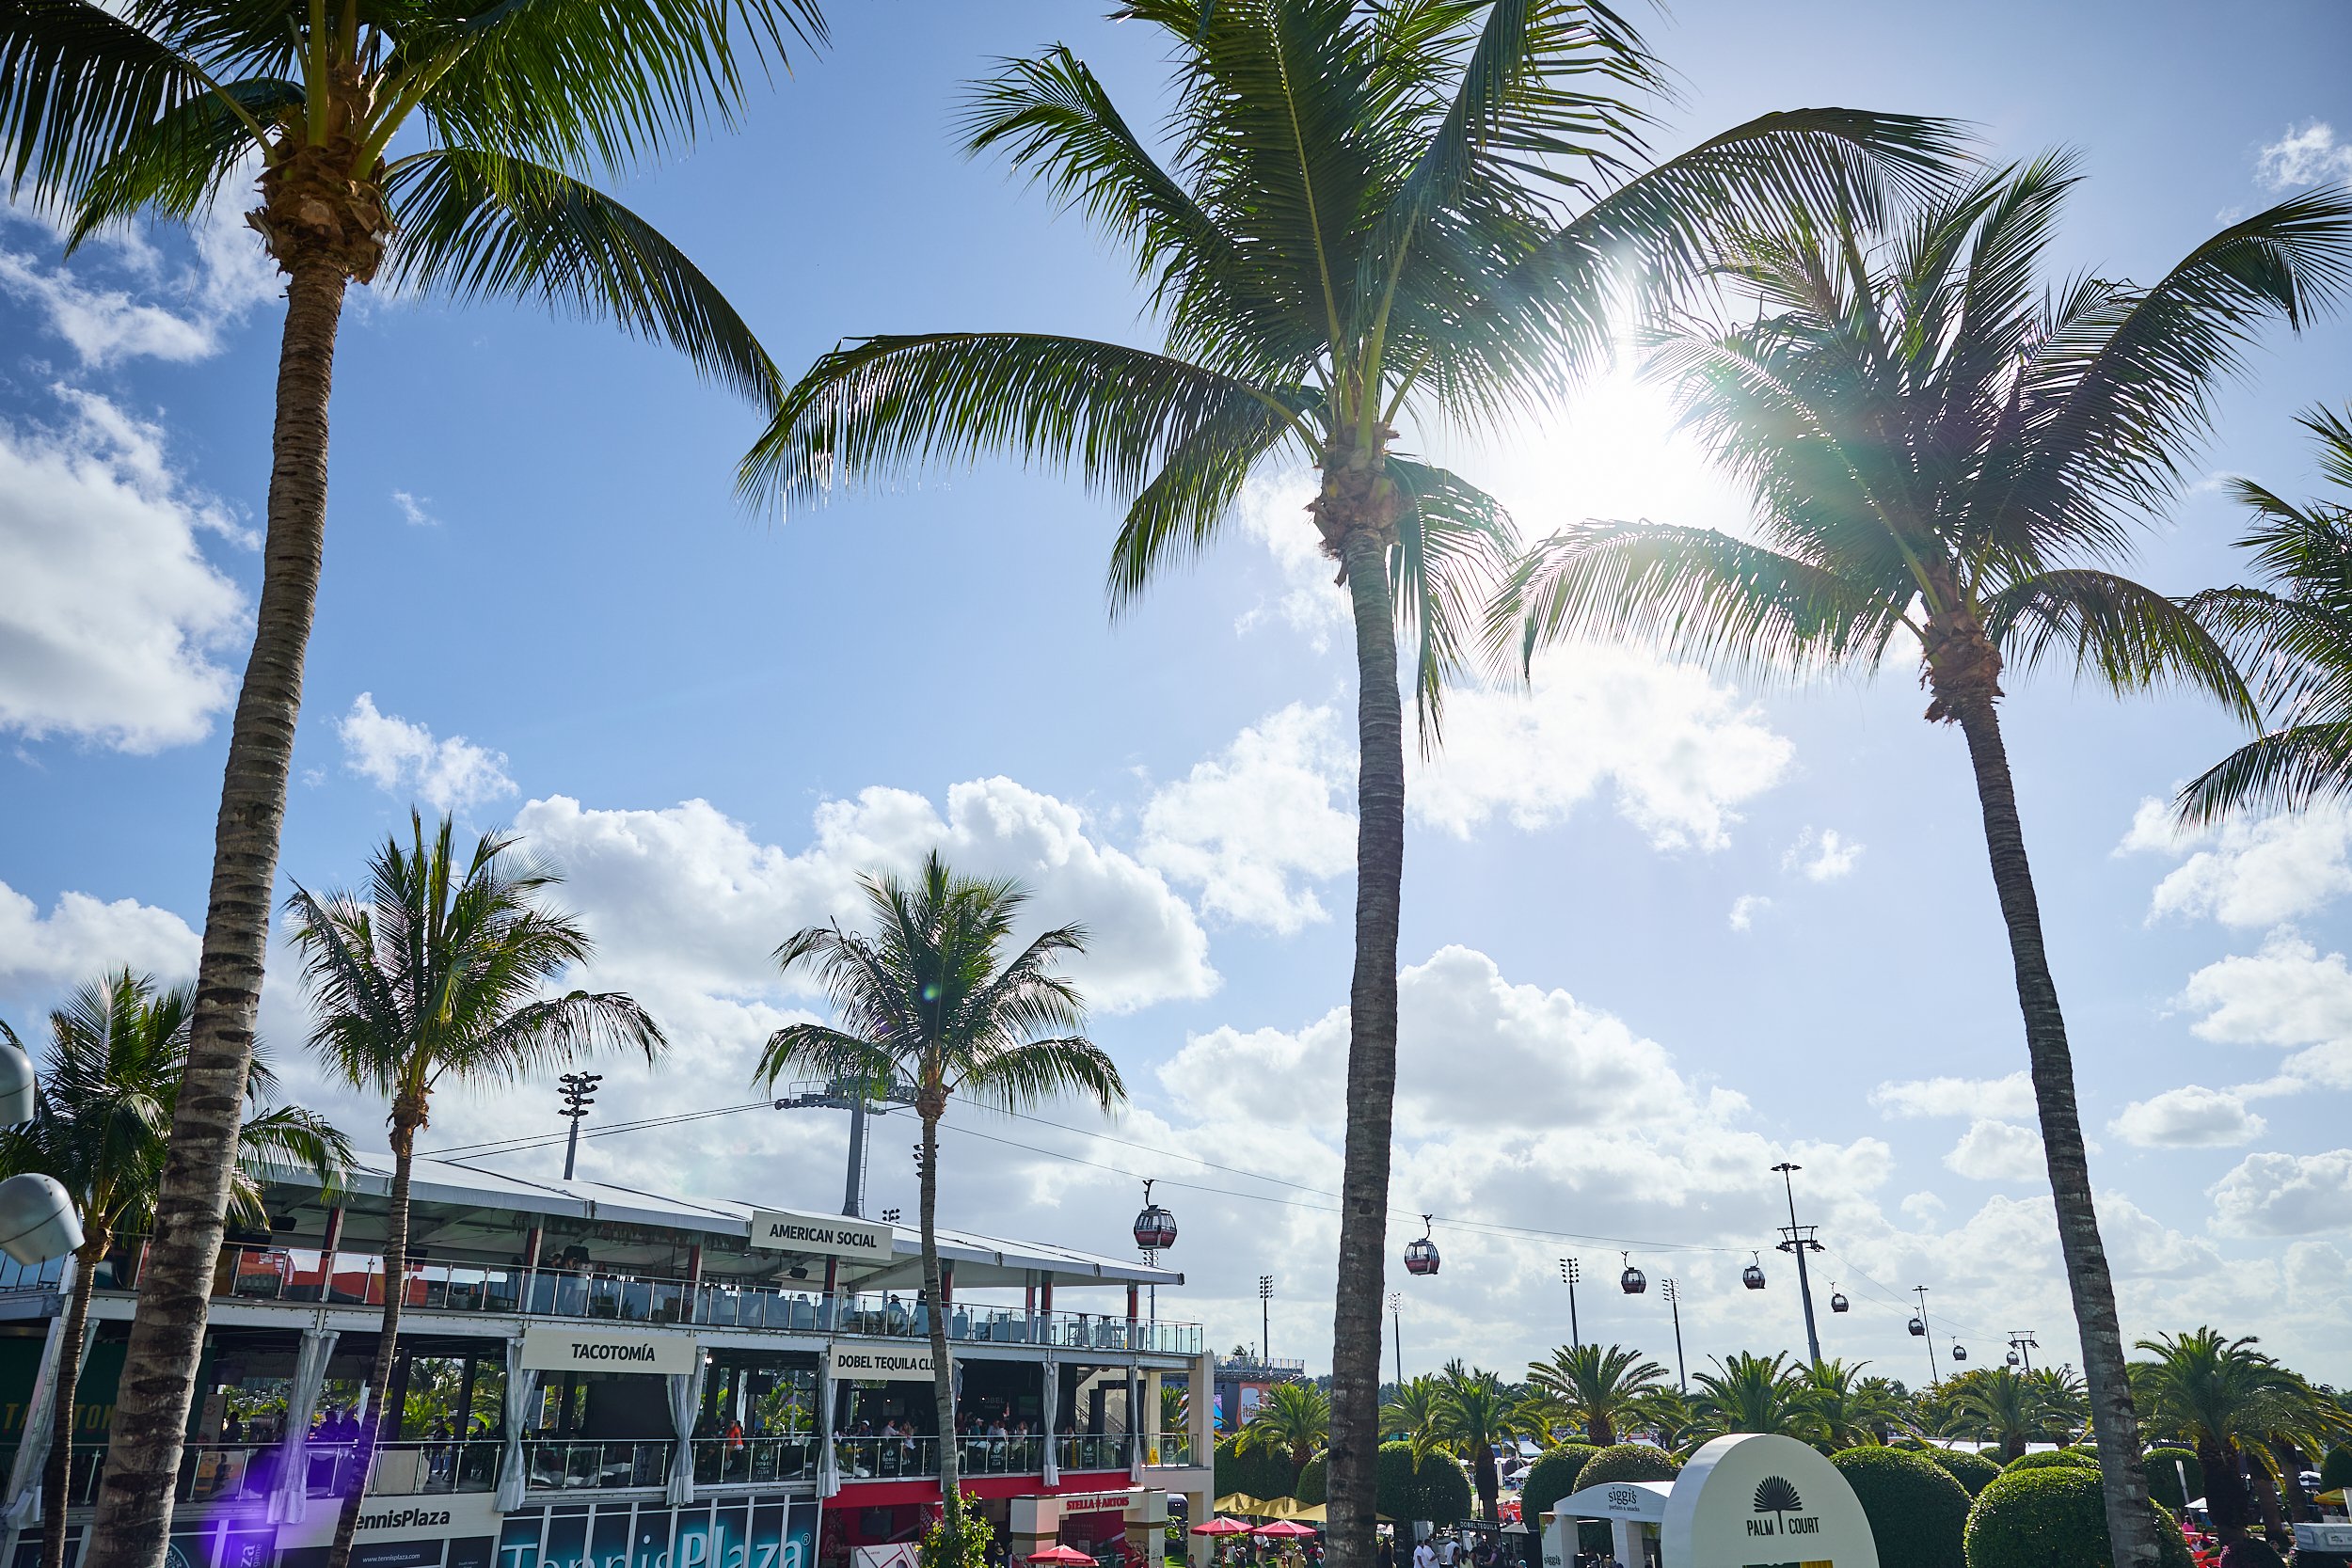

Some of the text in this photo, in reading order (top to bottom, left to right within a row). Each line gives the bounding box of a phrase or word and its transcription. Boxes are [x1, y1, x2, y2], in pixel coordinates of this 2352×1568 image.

[769, 1223, 877, 1248] AMERICAN SOCIAL
[571, 1342, 656, 1362] TACOTOMÍA
[837, 1354, 936, 1371] DOBEL TEQUILA CLU
[1066, 1497, 1130, 1511] STELLA ARTOIS
[1608, 1486, 1637, 1505] siggi's
[357, 1508, 451, 1530] ennisPlaza
[1459, 1521, 1498, 1530] DOBEL TEQUILA
[1746, 1517, 1820, 1536] PALM COURT
[362, 1553, 421, 1563] www.tennisplaza.com
